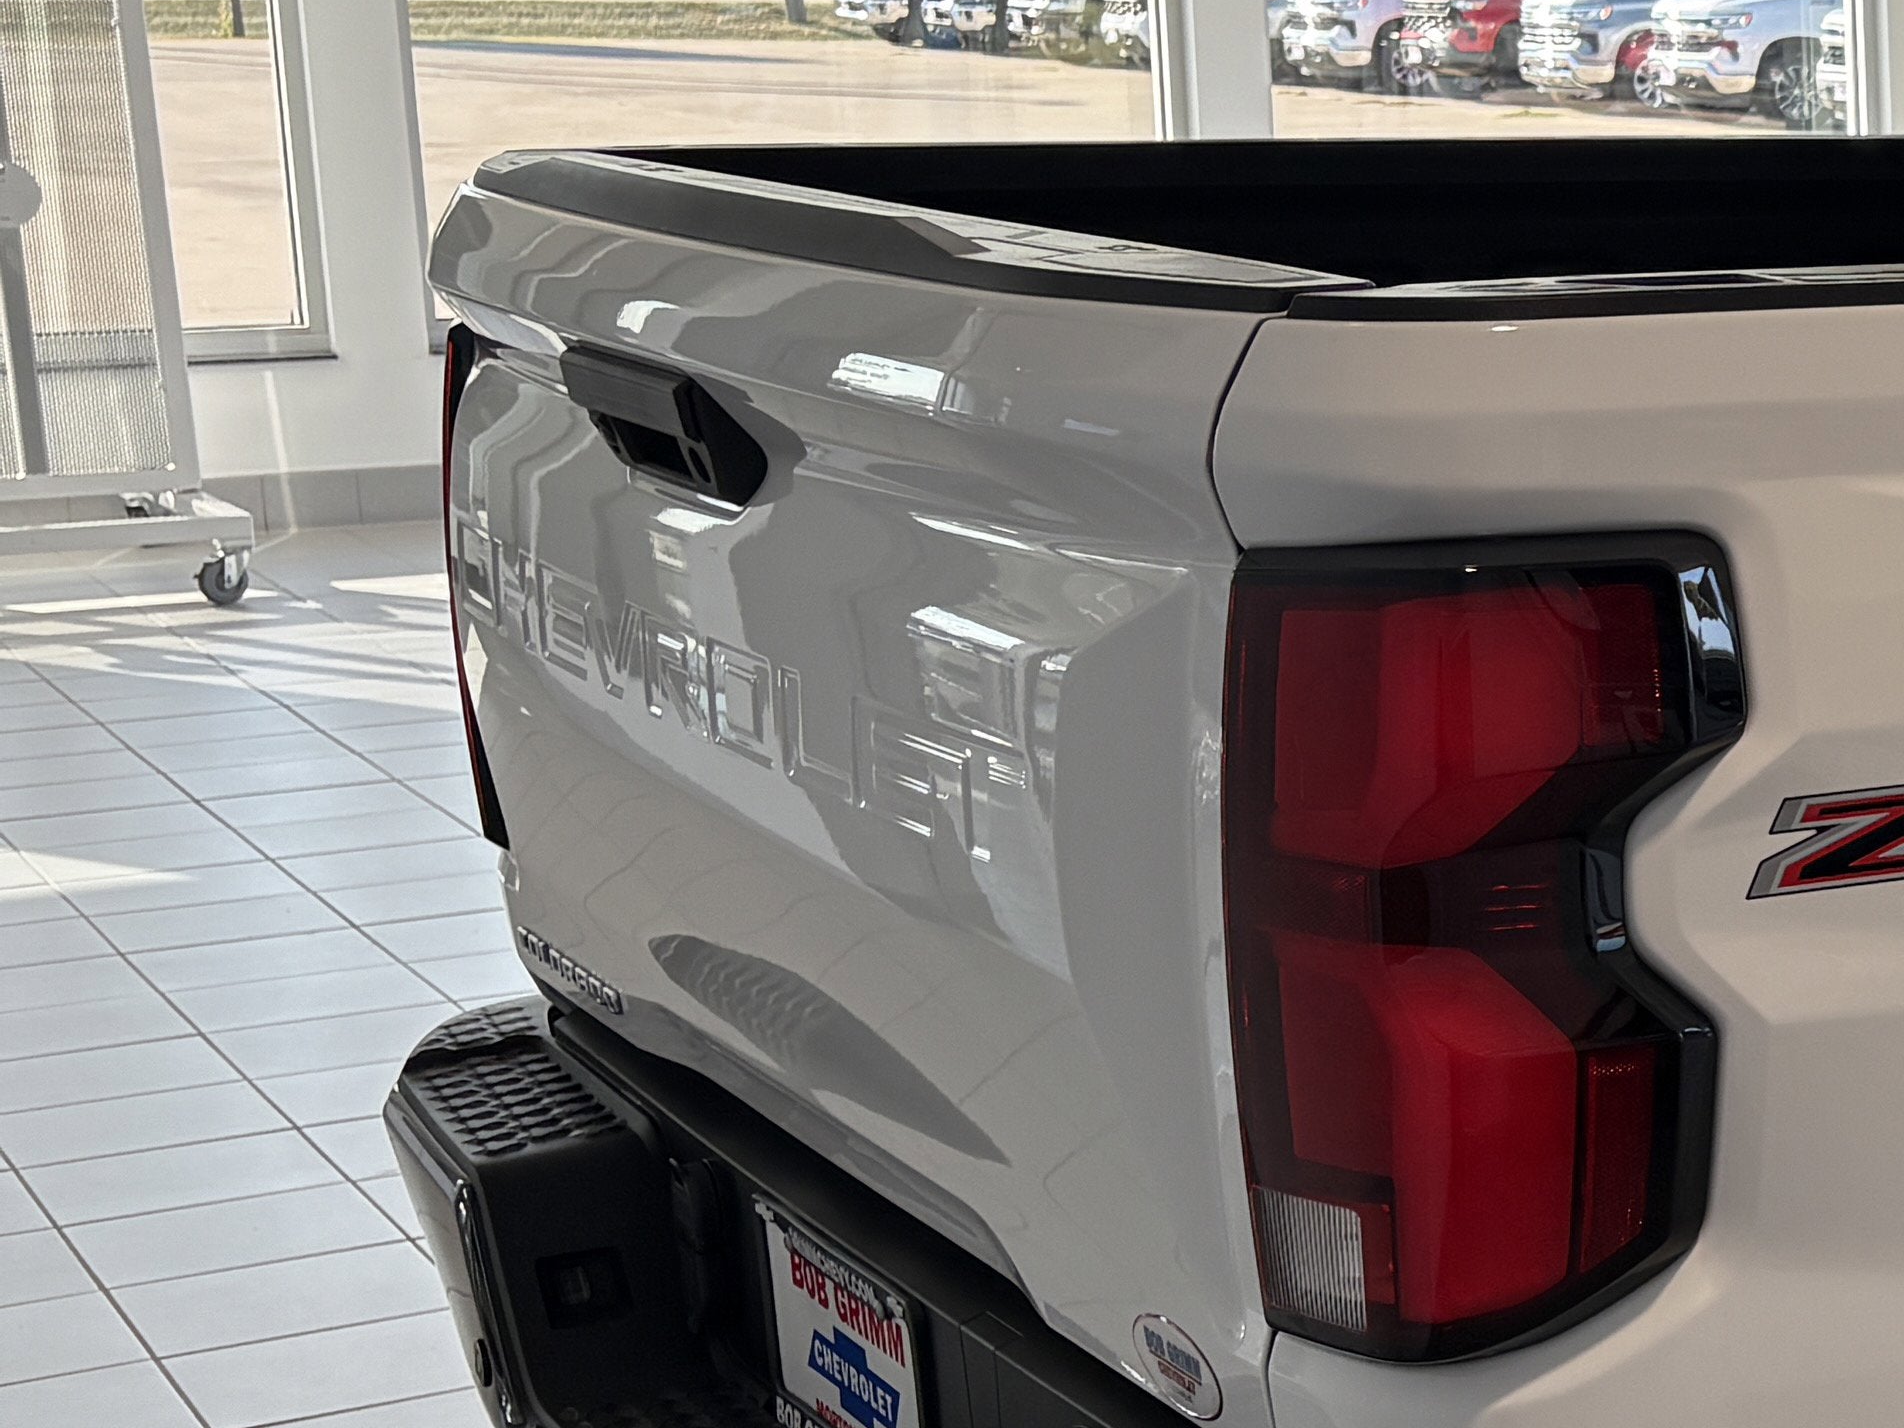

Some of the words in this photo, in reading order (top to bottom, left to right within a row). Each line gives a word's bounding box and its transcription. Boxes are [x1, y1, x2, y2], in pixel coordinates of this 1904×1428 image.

[456, 516, 1027, 864] CHEVROLET
[790, 1250, 830, 1310] BOB
[834, 1281, 906, 1369] GRIMM
[814, 1338, 893, 1422] CHEVROLET
